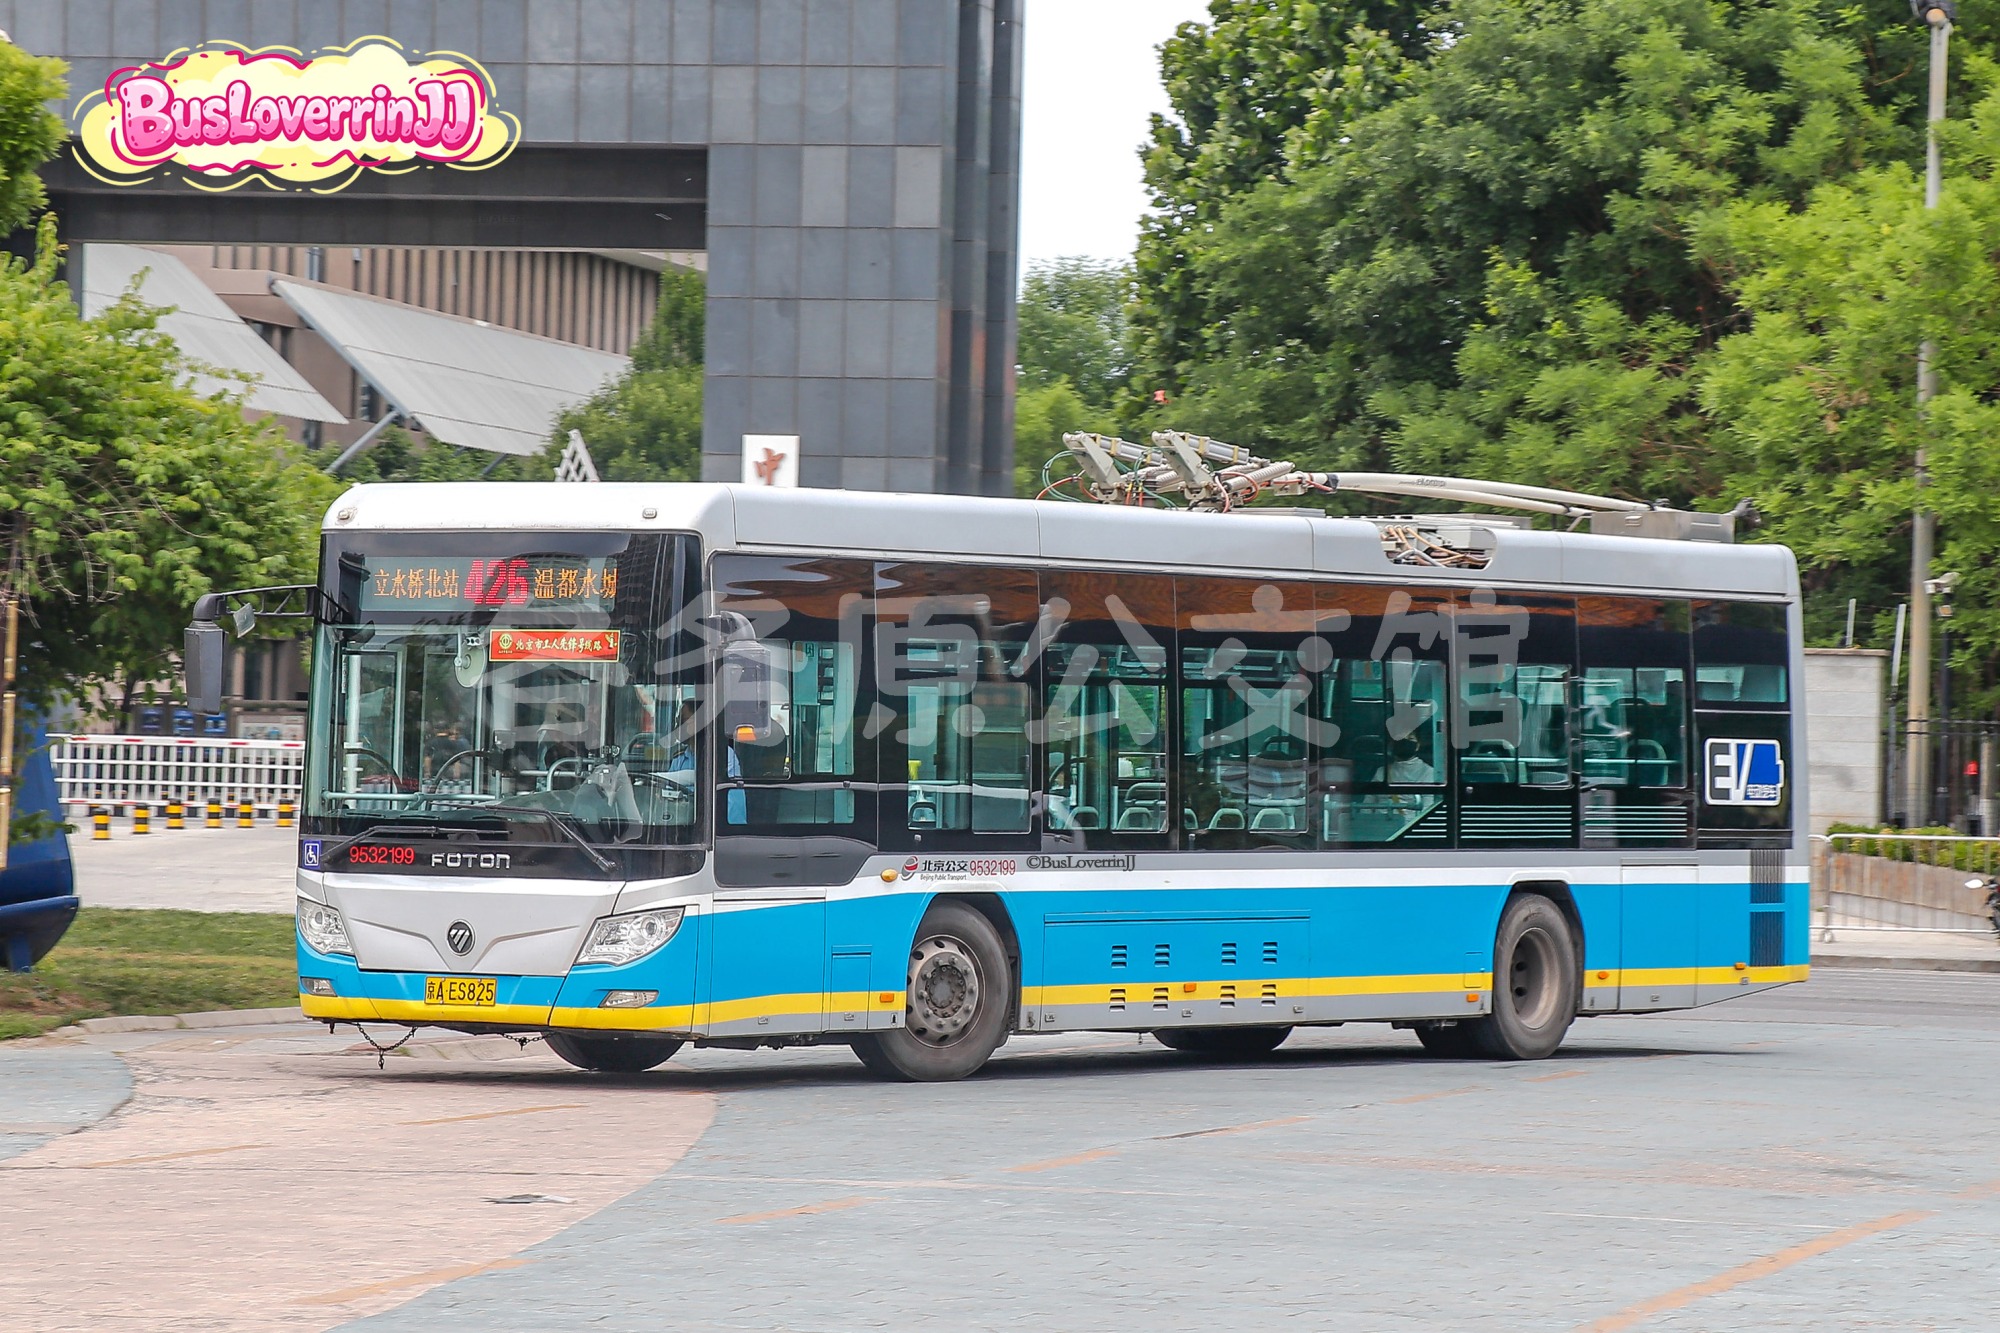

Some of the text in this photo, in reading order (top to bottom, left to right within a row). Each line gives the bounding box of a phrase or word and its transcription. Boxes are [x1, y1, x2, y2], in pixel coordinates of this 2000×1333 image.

[373, 559, 618, 605] 立水桥北站 426 温都水城
[515, 636, 603, 654] 北京市工人先锋号线路
[349, 846, 415, 865] 9532199
[431, 852, 511, 869] FOTON
[921, 859, 1016, 876] 北京公交 9532199
[920, 873, 934, 881] Beijing
[947, 873, 967, 881] Transport
